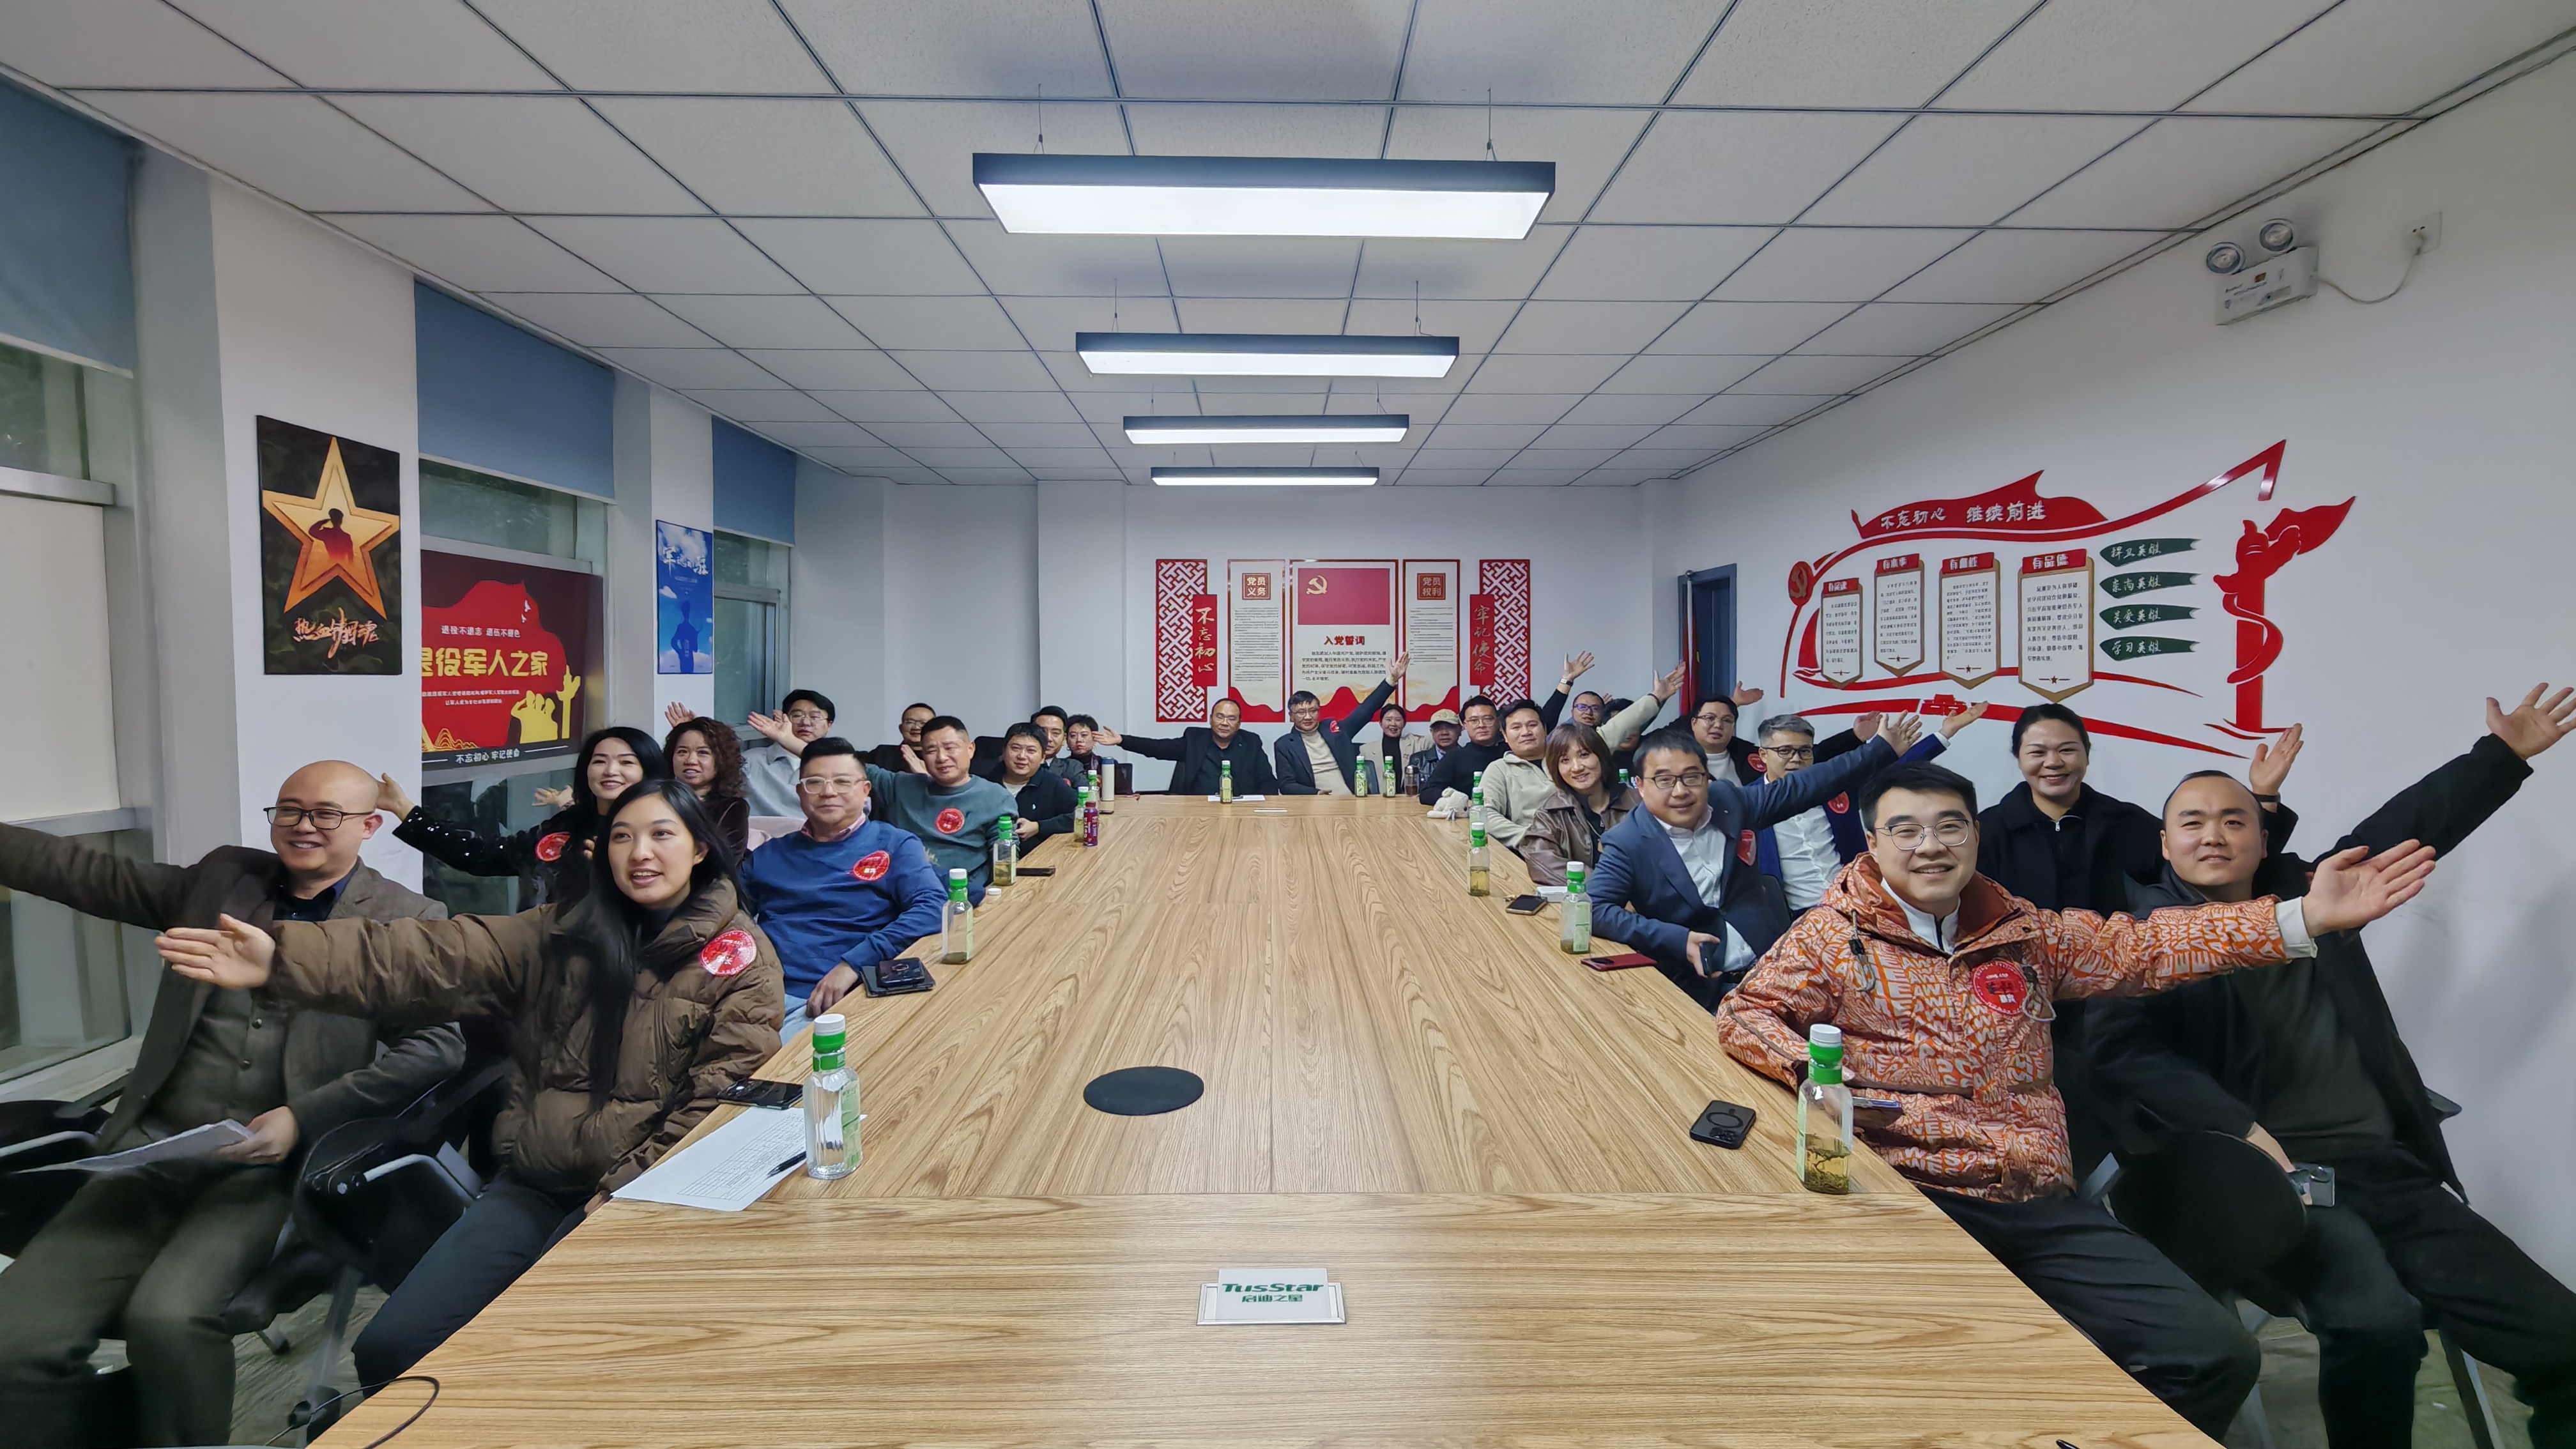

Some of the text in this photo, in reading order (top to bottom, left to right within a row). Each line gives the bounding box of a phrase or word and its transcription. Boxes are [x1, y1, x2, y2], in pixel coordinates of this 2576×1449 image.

[1880, 500, 2046, 530] 不忘初心 继续前进
[1195, 607, 1216, 673] 不忘初心
[1472, 605, 1492, 675] 牢记使命
[1222, 1283, 1324, 1292] TusStar
